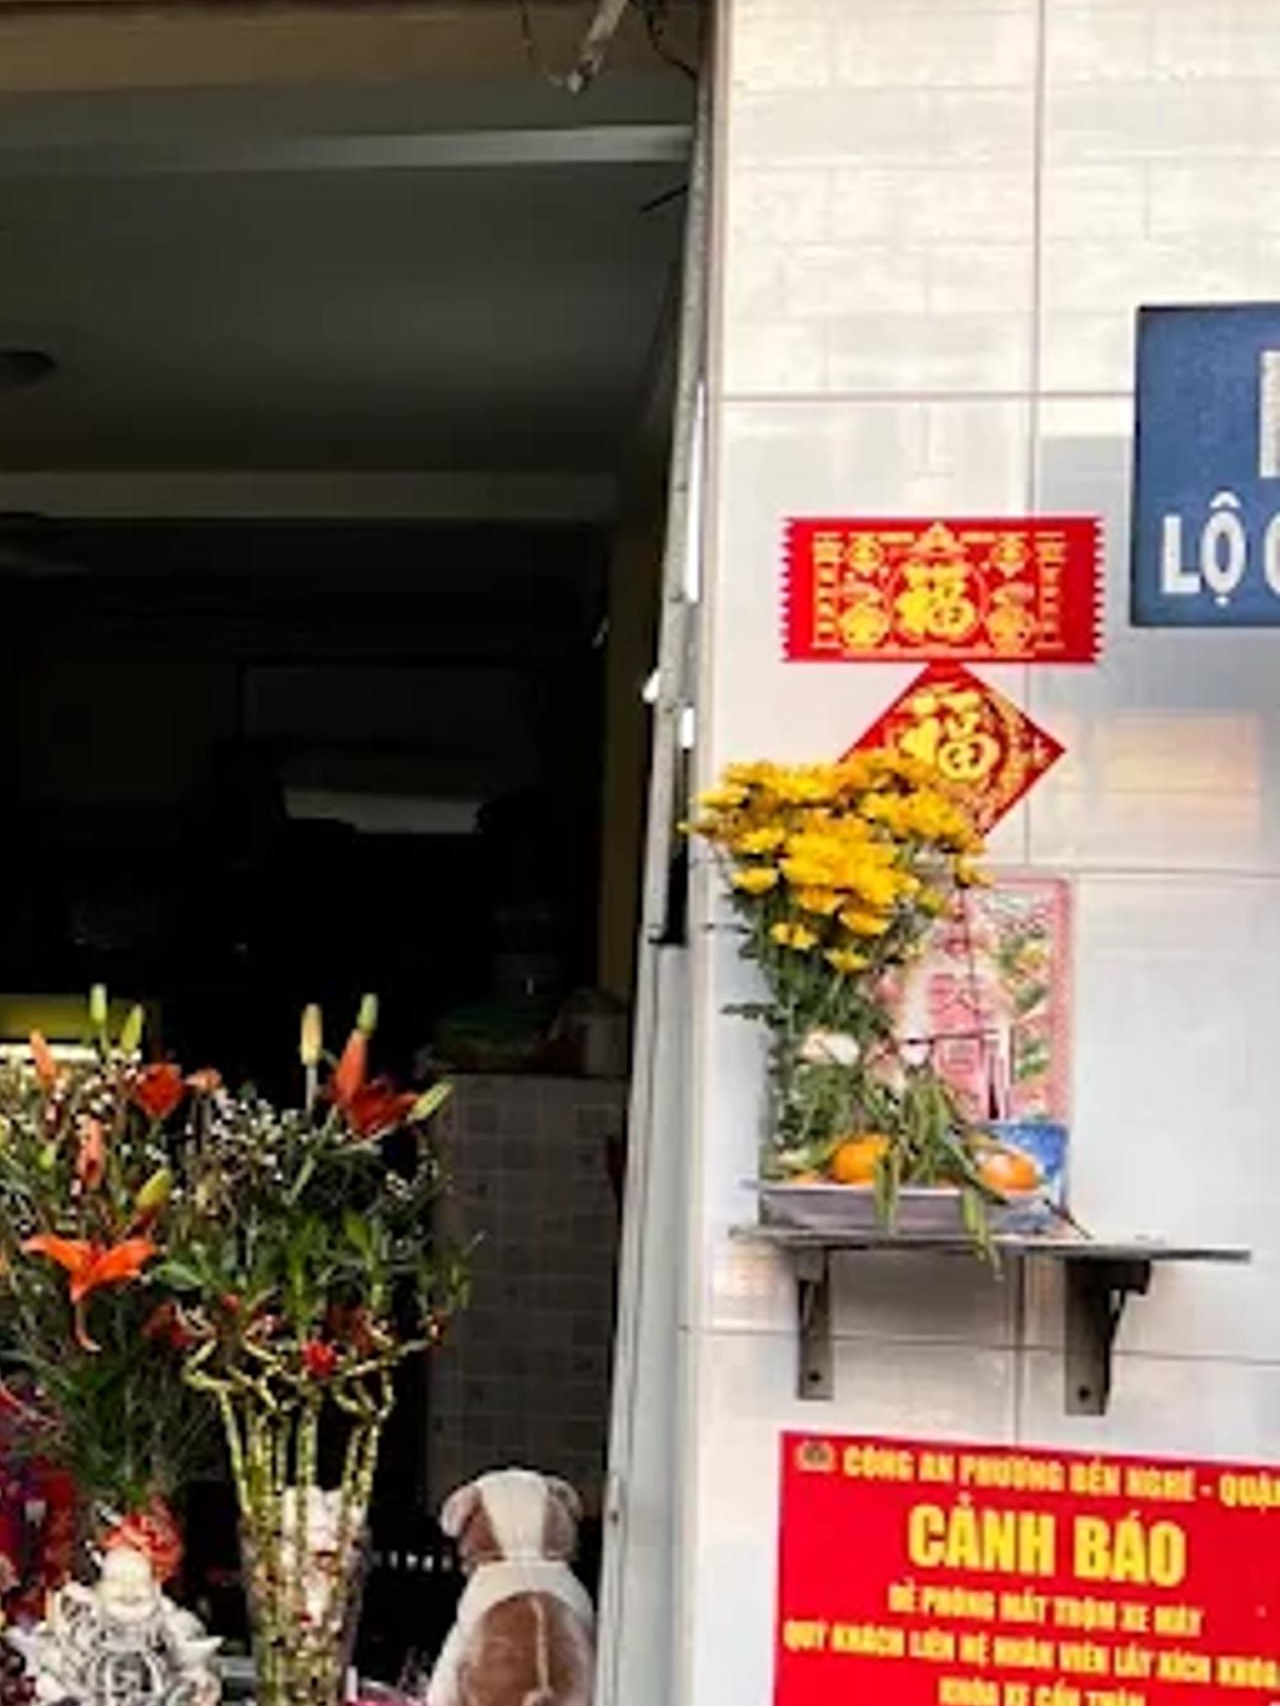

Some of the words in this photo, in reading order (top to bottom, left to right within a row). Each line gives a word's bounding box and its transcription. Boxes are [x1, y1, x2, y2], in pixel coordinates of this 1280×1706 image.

[1158, 490, 1246, 608] LỘ
[907, 1491, 1056, 1577] CẢNH
[1072, 1508, 1188, 1588] BÁO
